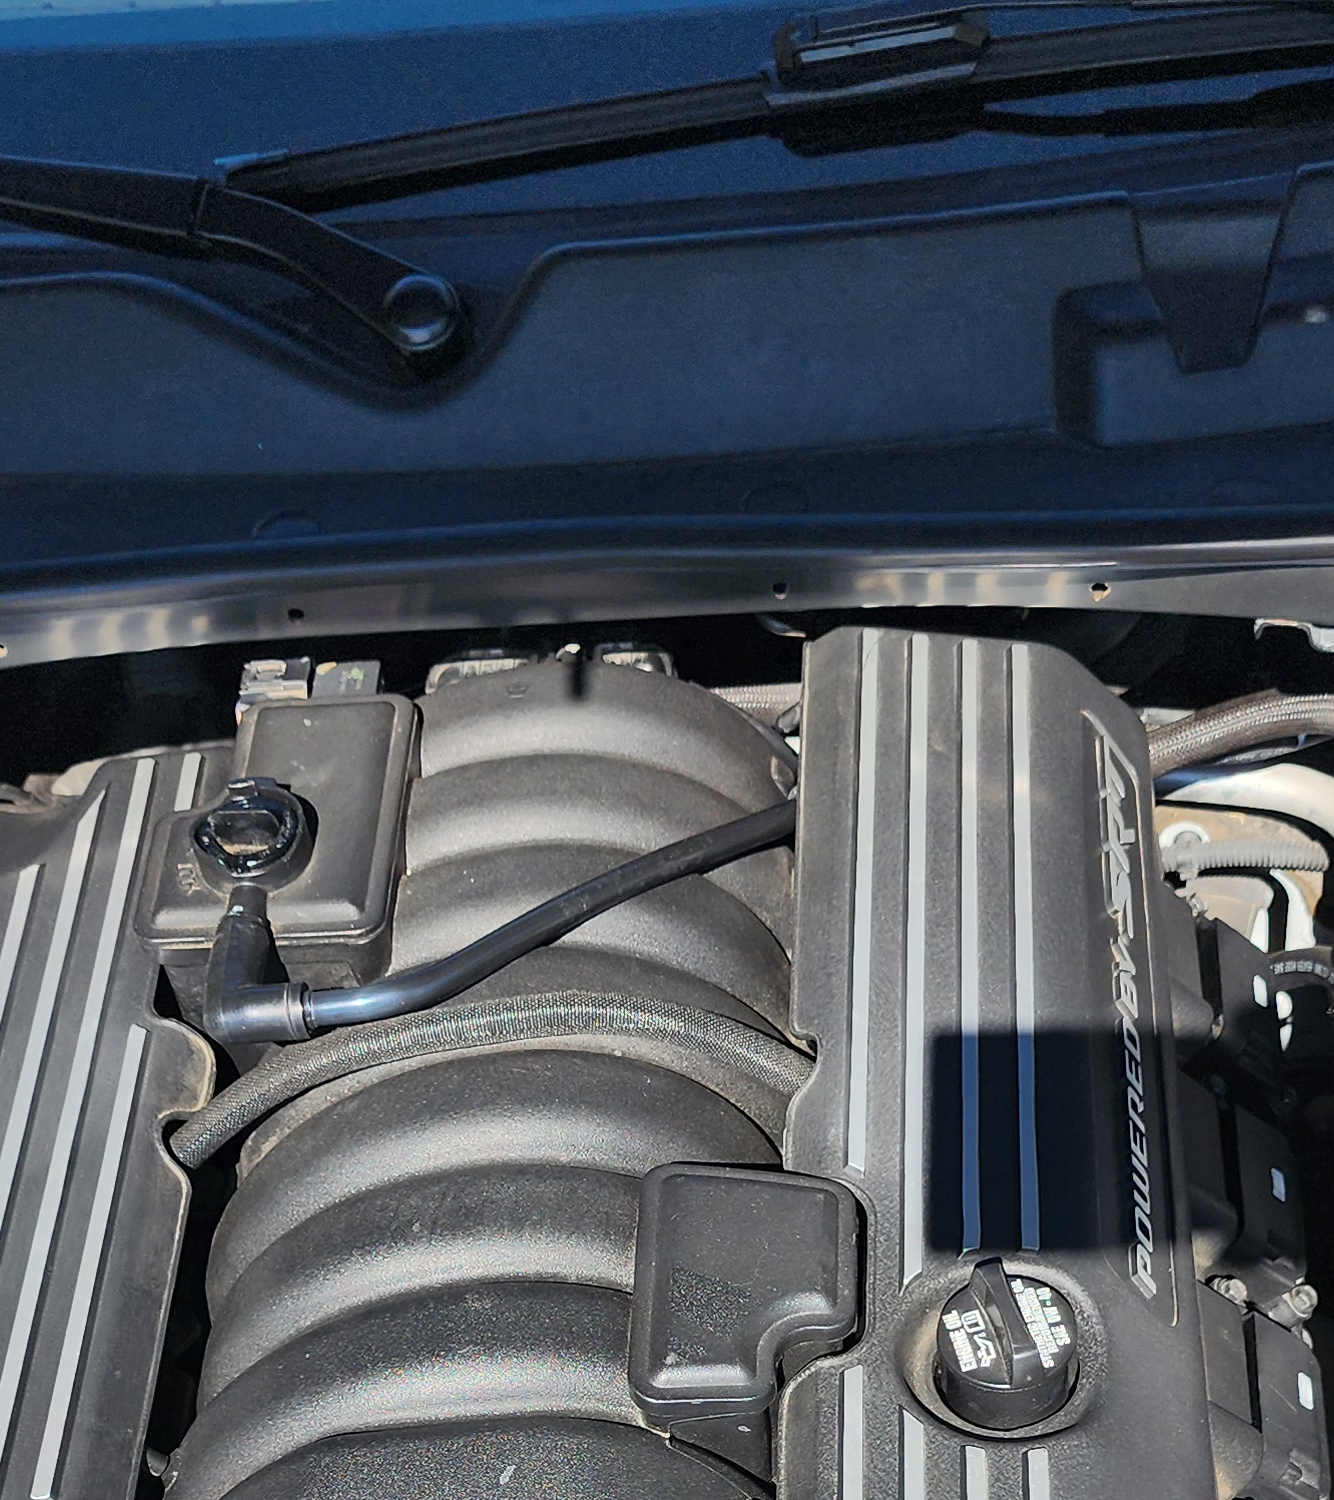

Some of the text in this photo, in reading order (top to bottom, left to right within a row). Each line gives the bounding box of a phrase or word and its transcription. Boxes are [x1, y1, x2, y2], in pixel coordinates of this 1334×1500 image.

[1095, 735, 1157, 1299] POWERED BY SRT
[942, 1309, 978, 1373] ENGINE OIL
[1010, 1278, 1055, 1369] SYNTHETIC ENGINE OIL
[1050, 1324, 1071, 1346] SAE
